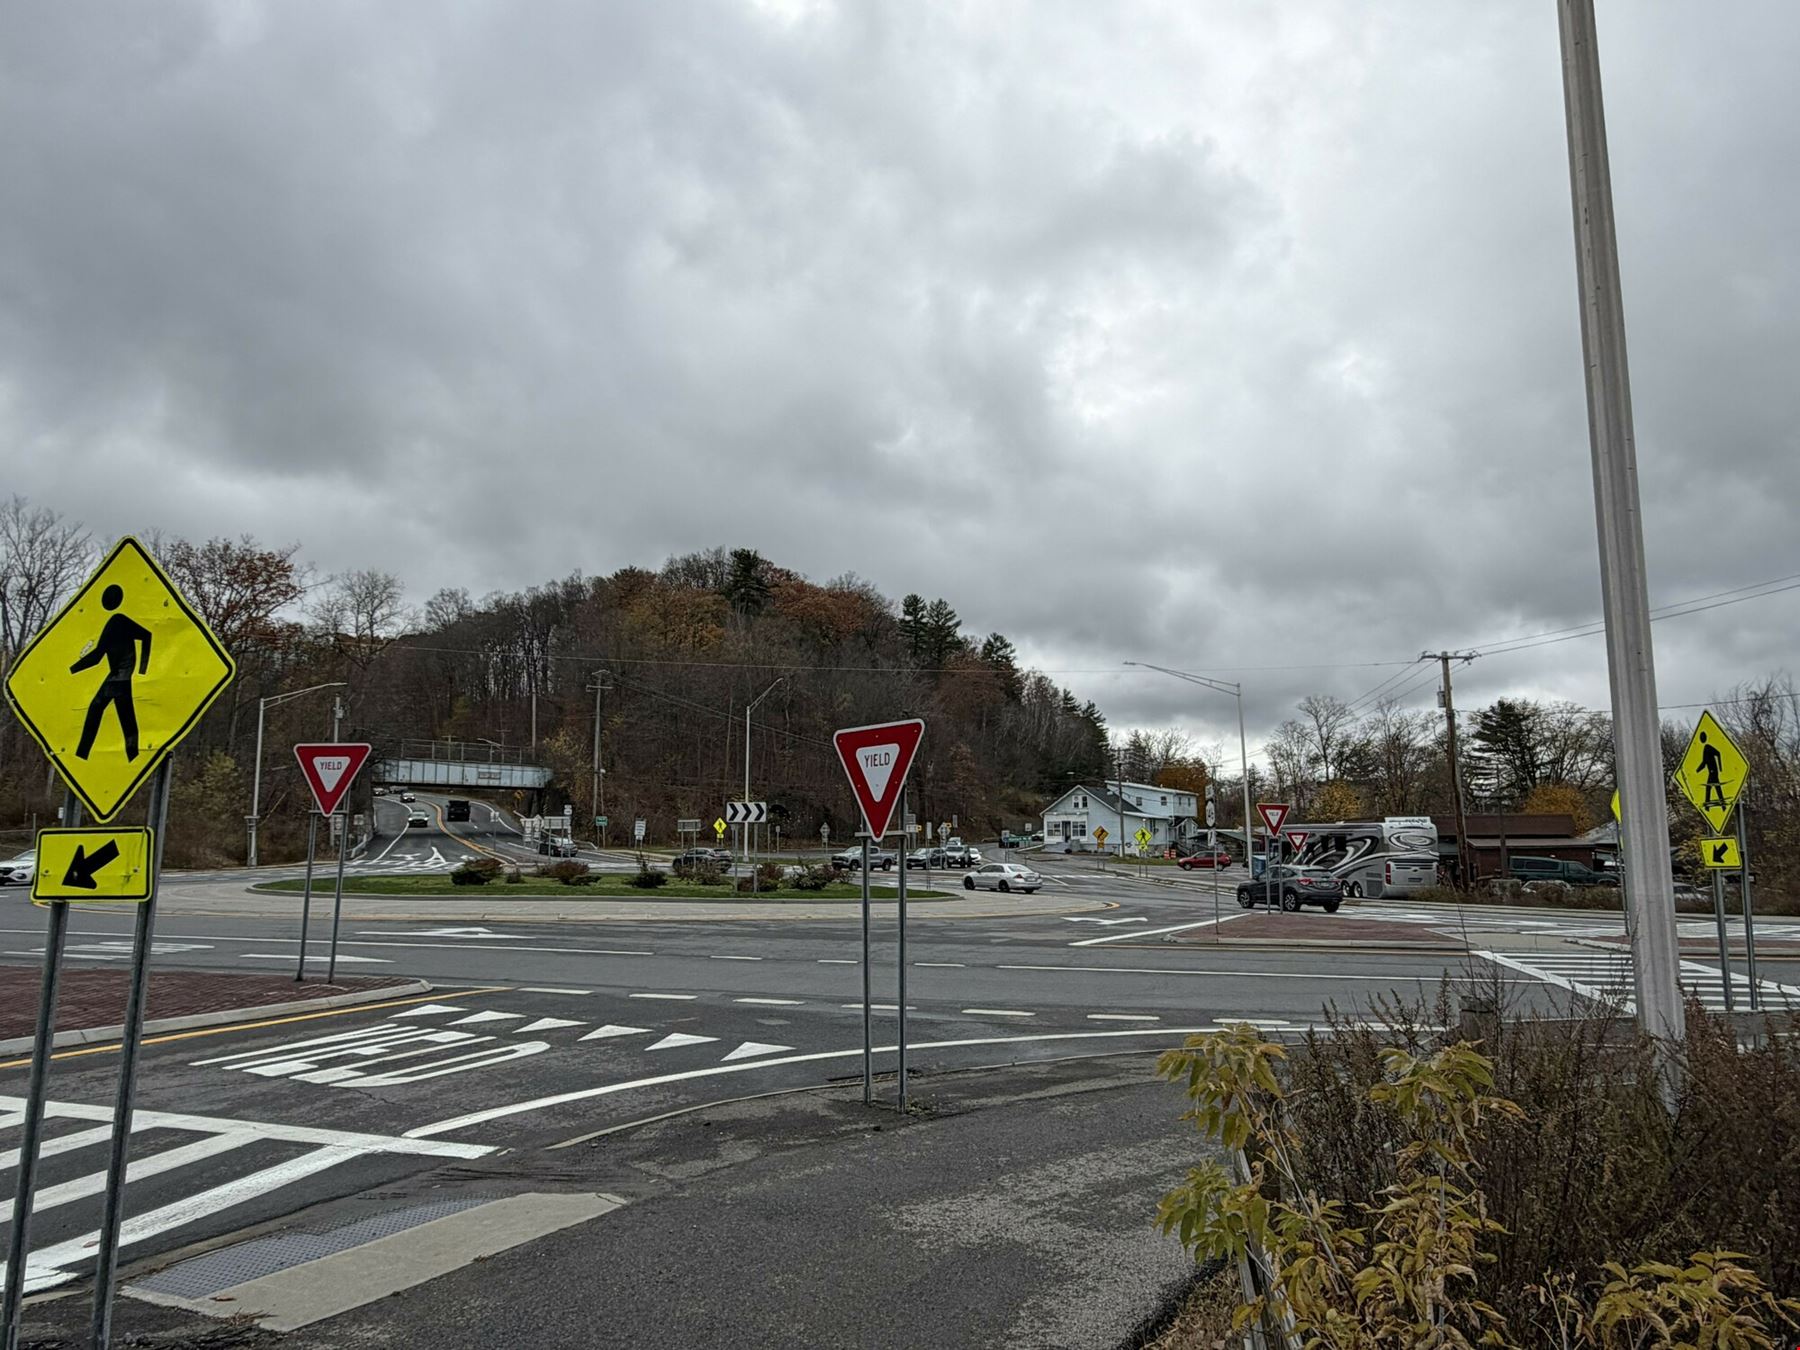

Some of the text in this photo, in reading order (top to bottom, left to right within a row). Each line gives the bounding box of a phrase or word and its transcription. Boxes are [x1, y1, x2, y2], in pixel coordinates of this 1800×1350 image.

[319, 760, 343, 771] YIELD
[863, 752, 891, 768] YIELD
[188, 1022, 552, 1088] YIELD
